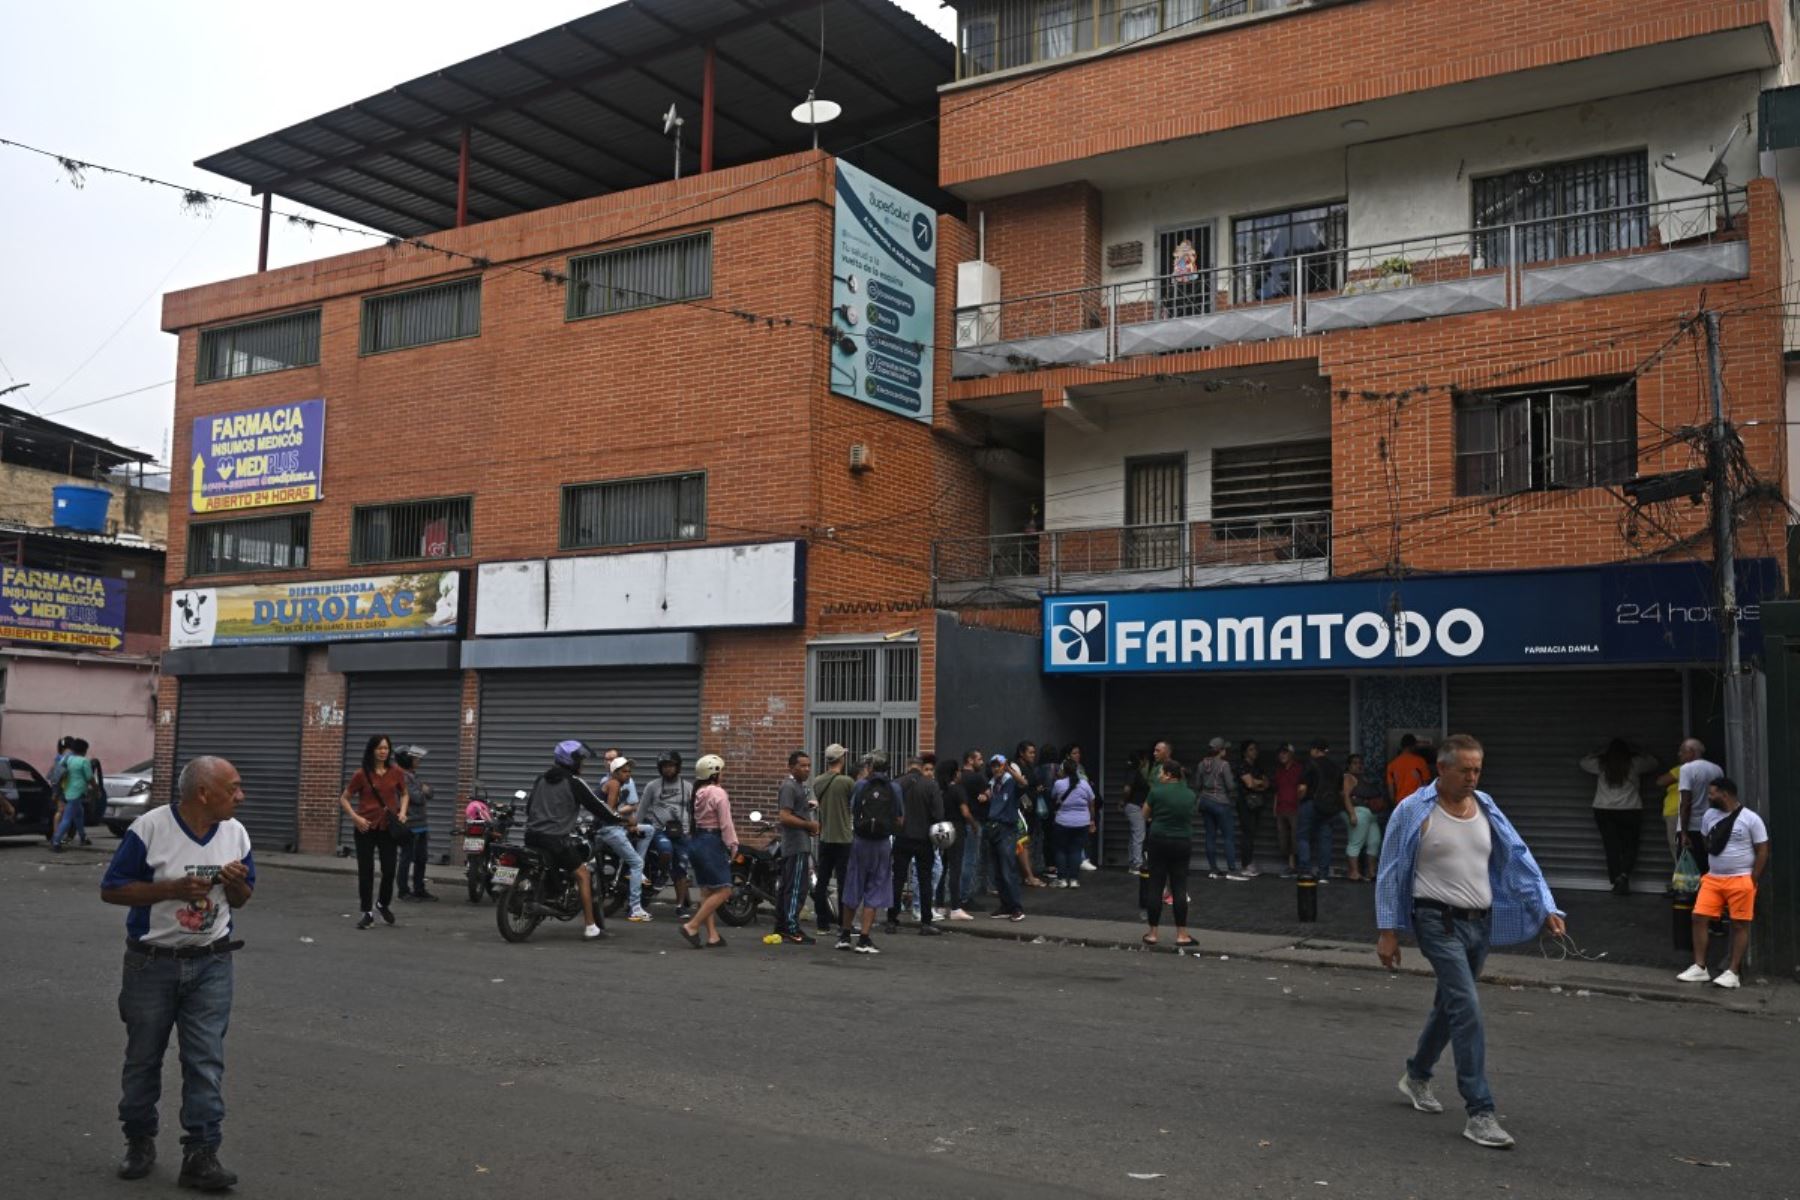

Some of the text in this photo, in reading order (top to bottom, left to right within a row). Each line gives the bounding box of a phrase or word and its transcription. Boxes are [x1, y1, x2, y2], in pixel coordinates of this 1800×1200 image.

[841, 254, 863, 269] vuelta
[863, 264, 872, 274] de
[879, 271, 904, 287] esquina
[212, 407, 304, 441] FARMACIA
[211, 439, 256, 457] INSUMOS
[206, 487, 310, 510] ABIERTO 24 HORAS
[2, 567, 105, 597] FARMACIA
[288, 581, 376, 598] DISTRIBUIDORA
[1, 585, 54, 602] INSUMOS
[252, 591, 416, 625] DUROLAC
[1616, 602, 1662, 624] 24
[51, 633, 68, 642] 24
[71, 633, 111, 646] HORAS
[1115, 607, 1485, 665] FARMATODO
[1524, 644, 1600, 654] FARMACIA DANILA
